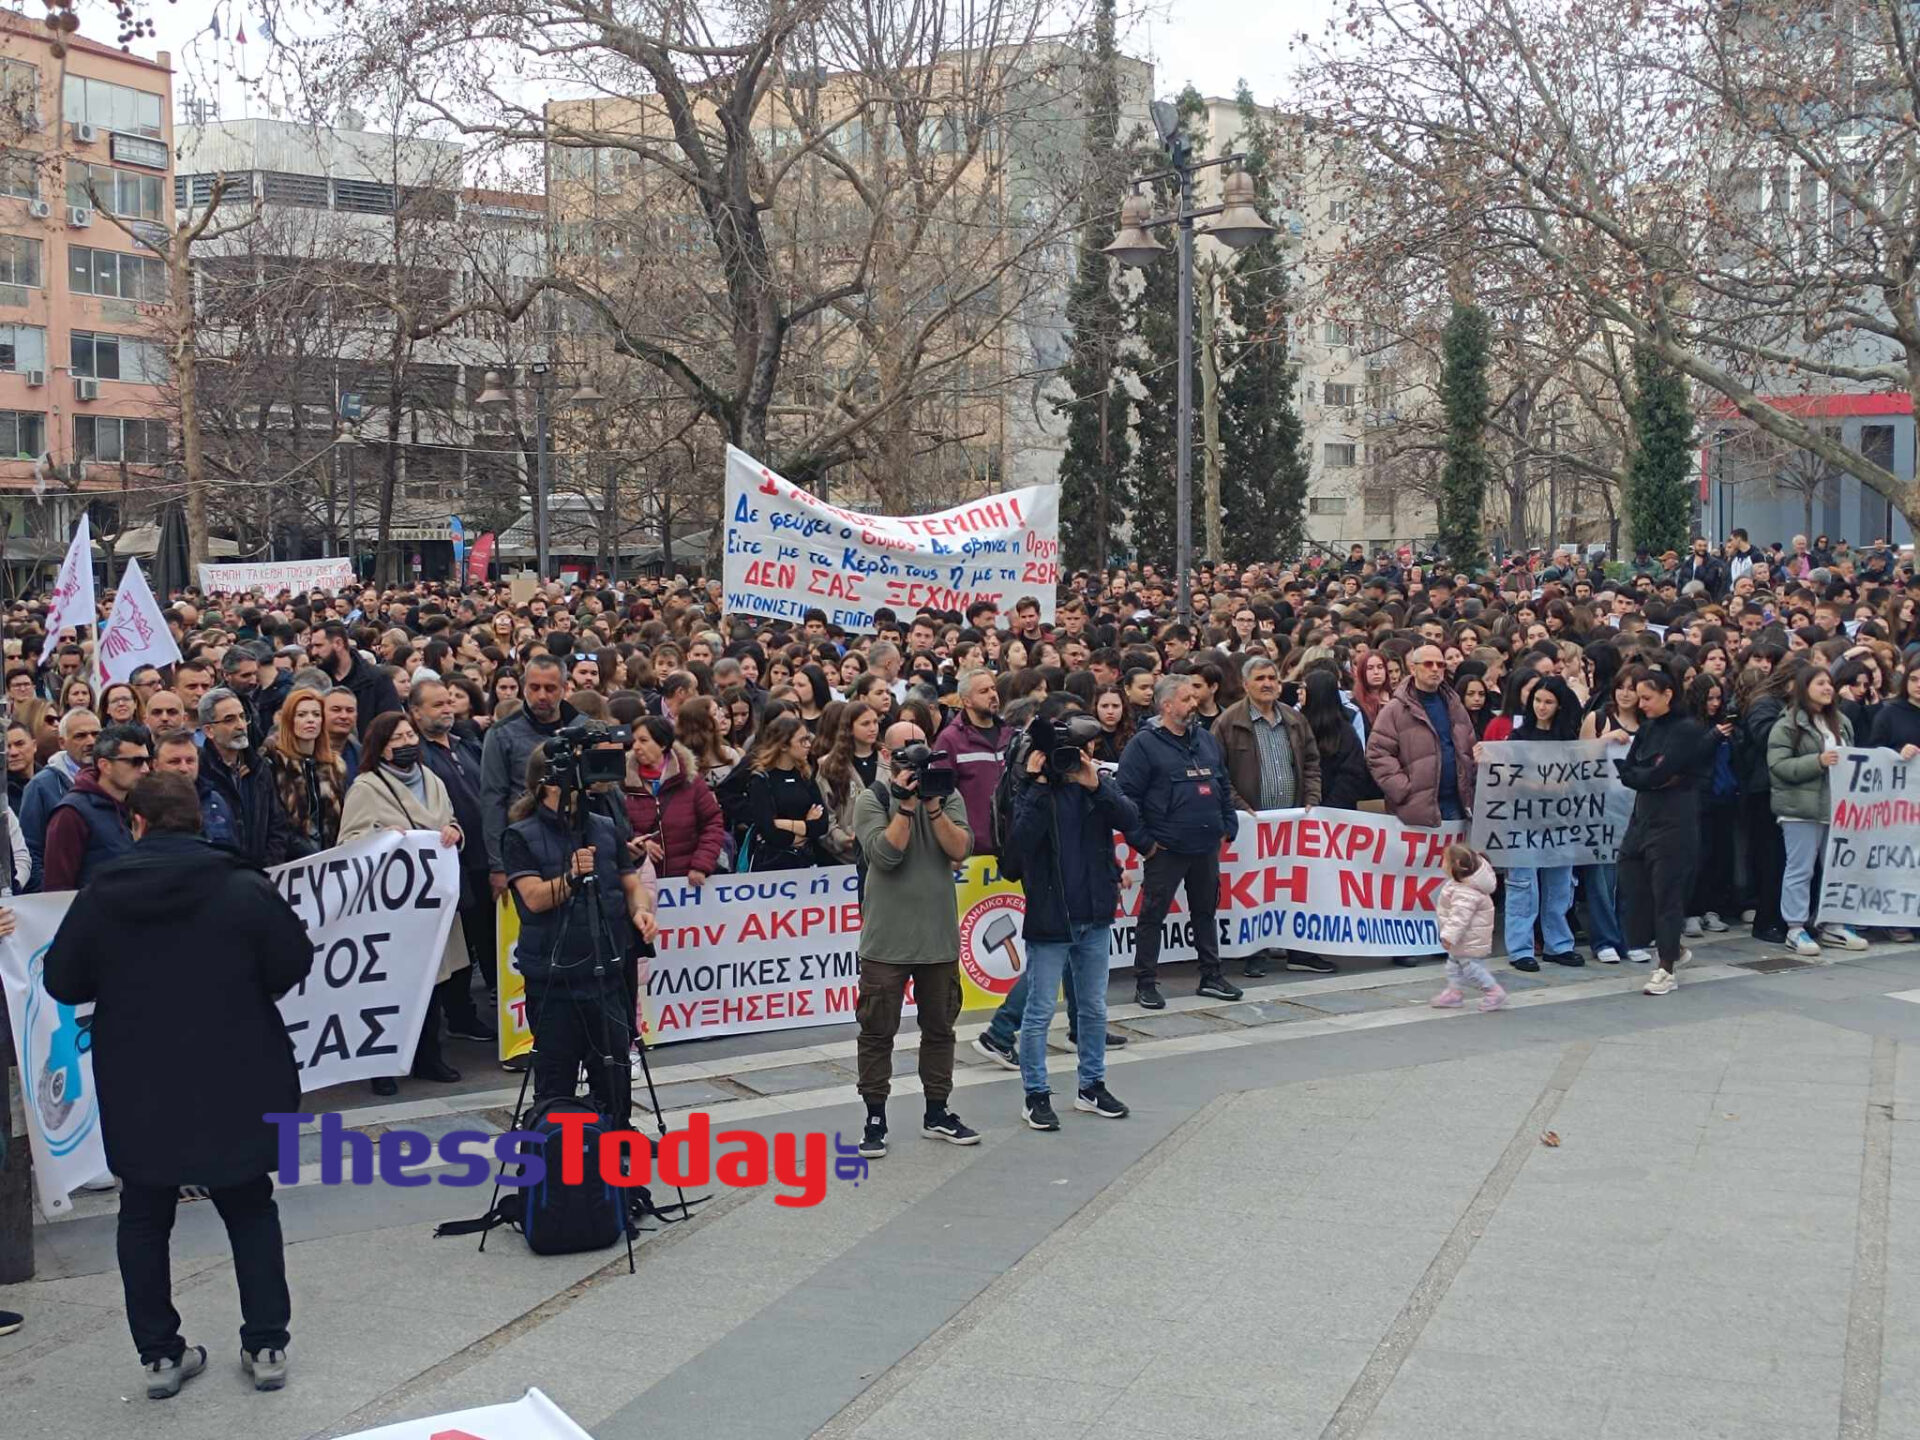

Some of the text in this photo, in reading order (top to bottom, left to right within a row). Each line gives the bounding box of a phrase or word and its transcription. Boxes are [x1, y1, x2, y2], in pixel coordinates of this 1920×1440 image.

[734, 493, 759, 523] Δε
[770, 511, 832, 537] φεύγει
[840, 526, 852, 540] ο
[898, 498, 1026, 535] ΤΕΜΠΗ!
[744, 560, 796, 590] ΔΕΝ
[808, 569, 865, 602] ΣΑΣ
[778, 544, 799, 561] με
[905, 564, 938, 580] τους
[971, 569, 992, 587] με
[1000, 569, 1016, 580] τη
[1487, 763, 1524, 787] 57
[1538, 759, 1609, 785] ΨΥΧΕΣ
[1892, 766, 1907, 790] Η
[1486, 792, 1605, 820] ΖΗΤΟΥΝ
[1257, 819, 1386, 864] ΜΕΧΡΙ
[1866, 845, 1920, 869] ΕΓΚΛ
[715, 880, 798, 903] τους
[810, 873, 829, 895] ή
[1238, 910, 1287, 945] ΑΓΙΟΥ
[1293, 911, 1354, 943] ΘΩΜΑ
[657, 989, 815, 1032] ΑΥΞΗΣΕΙΣ
